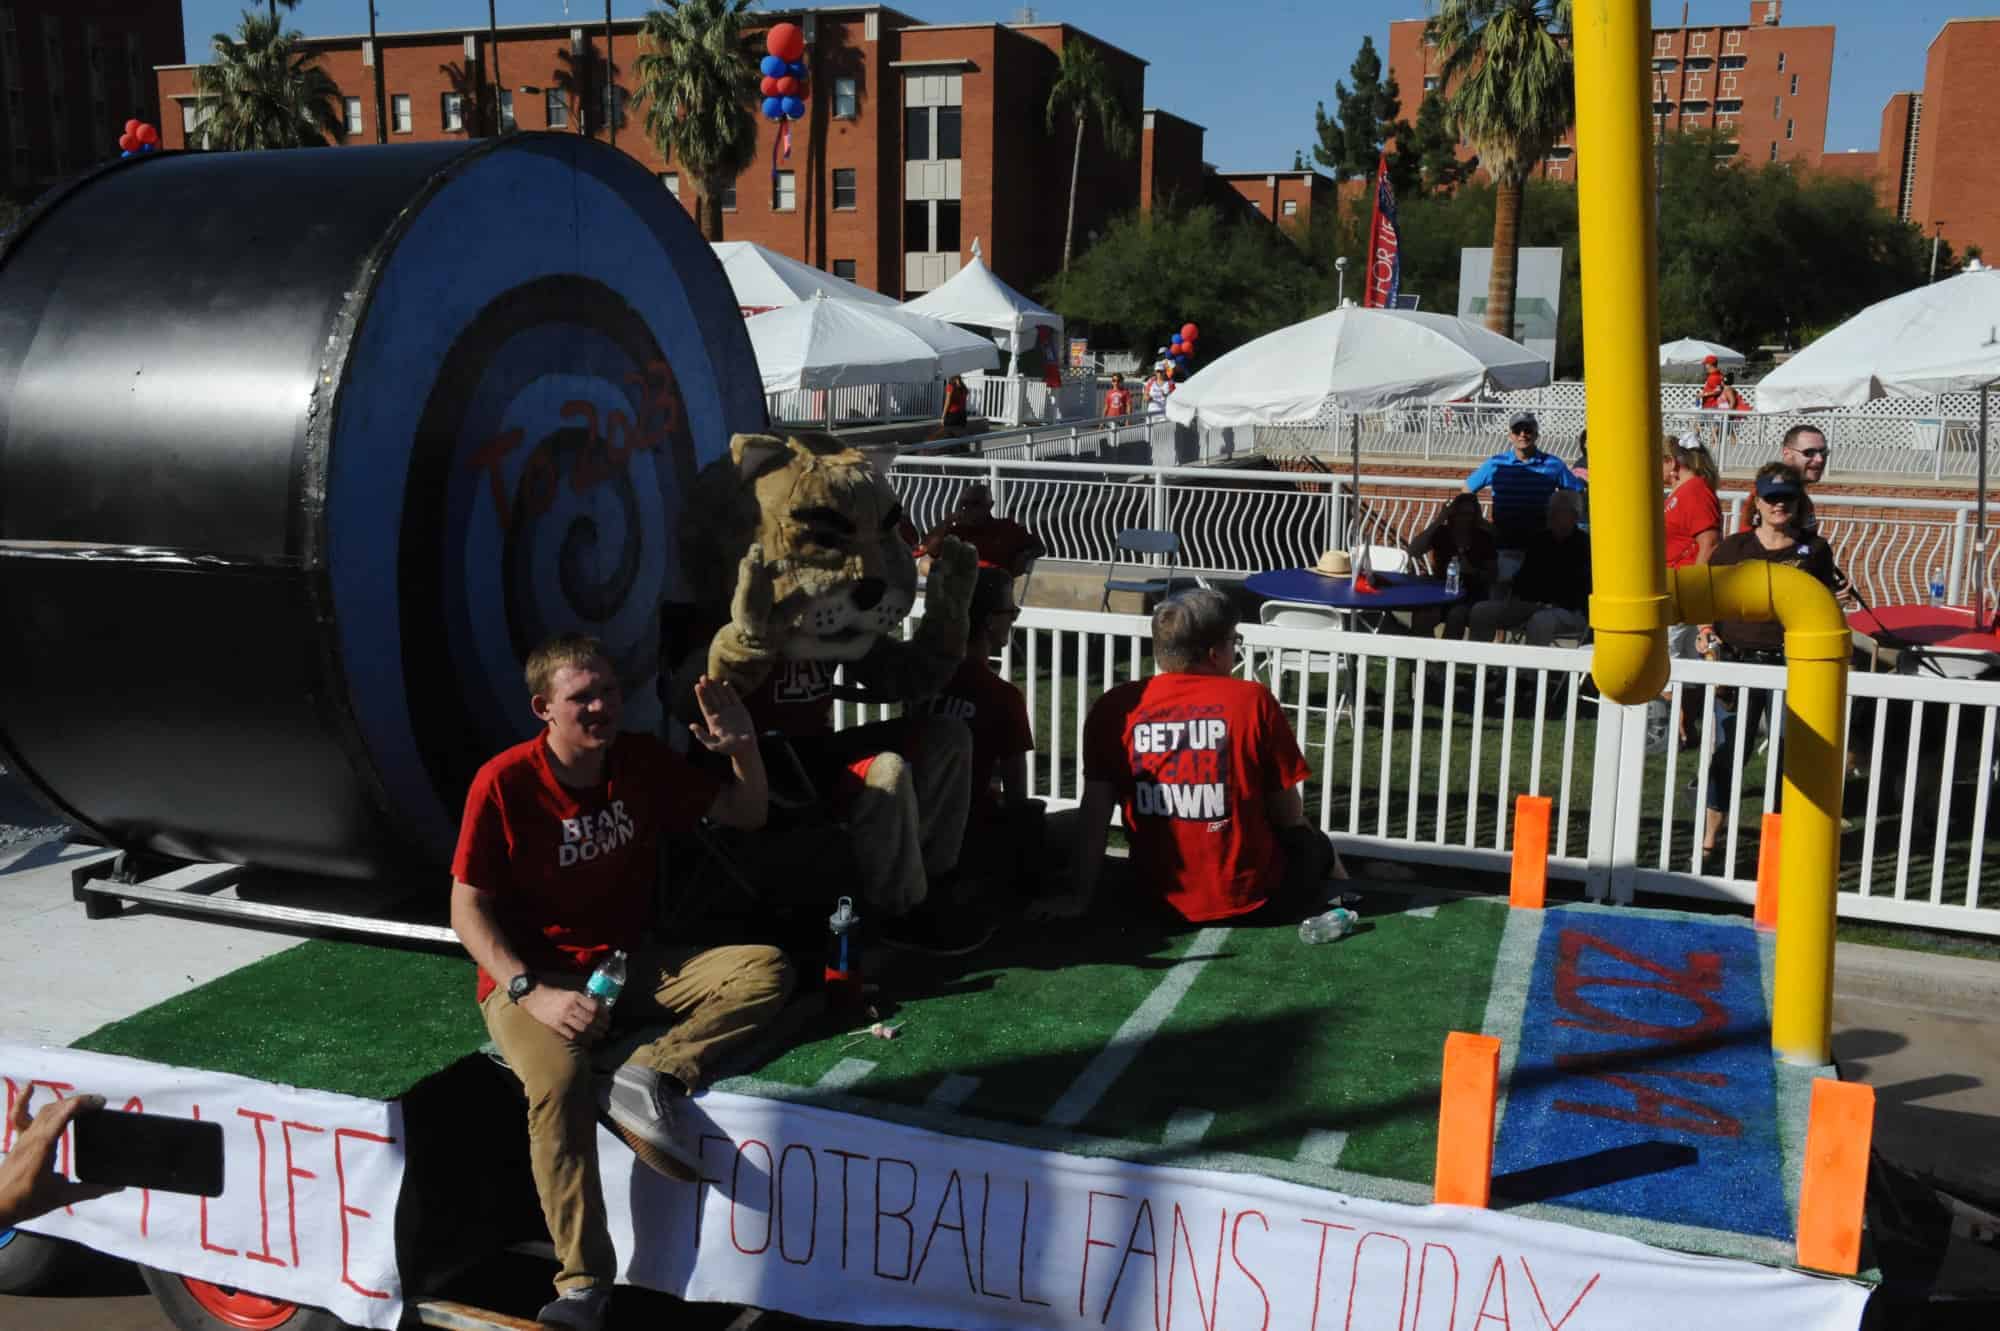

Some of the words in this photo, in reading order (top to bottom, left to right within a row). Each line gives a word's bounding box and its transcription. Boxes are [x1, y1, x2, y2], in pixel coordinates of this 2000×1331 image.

[465, 428, 558, 528] To
[1133, 721, 1186, 753] GET
[1188, 719, 1226, 750] UP
[562, 800, 628, 843] BEAR
[1136, 782, 1225, 819] DOWN
[559, 820, 634, 866] DOWN
[193, 1104, 397, 1298] LIFE
[695, 1134, 1051, 1306] FOOTBALL
[1079, 1190, 1270, 1331] FANS
